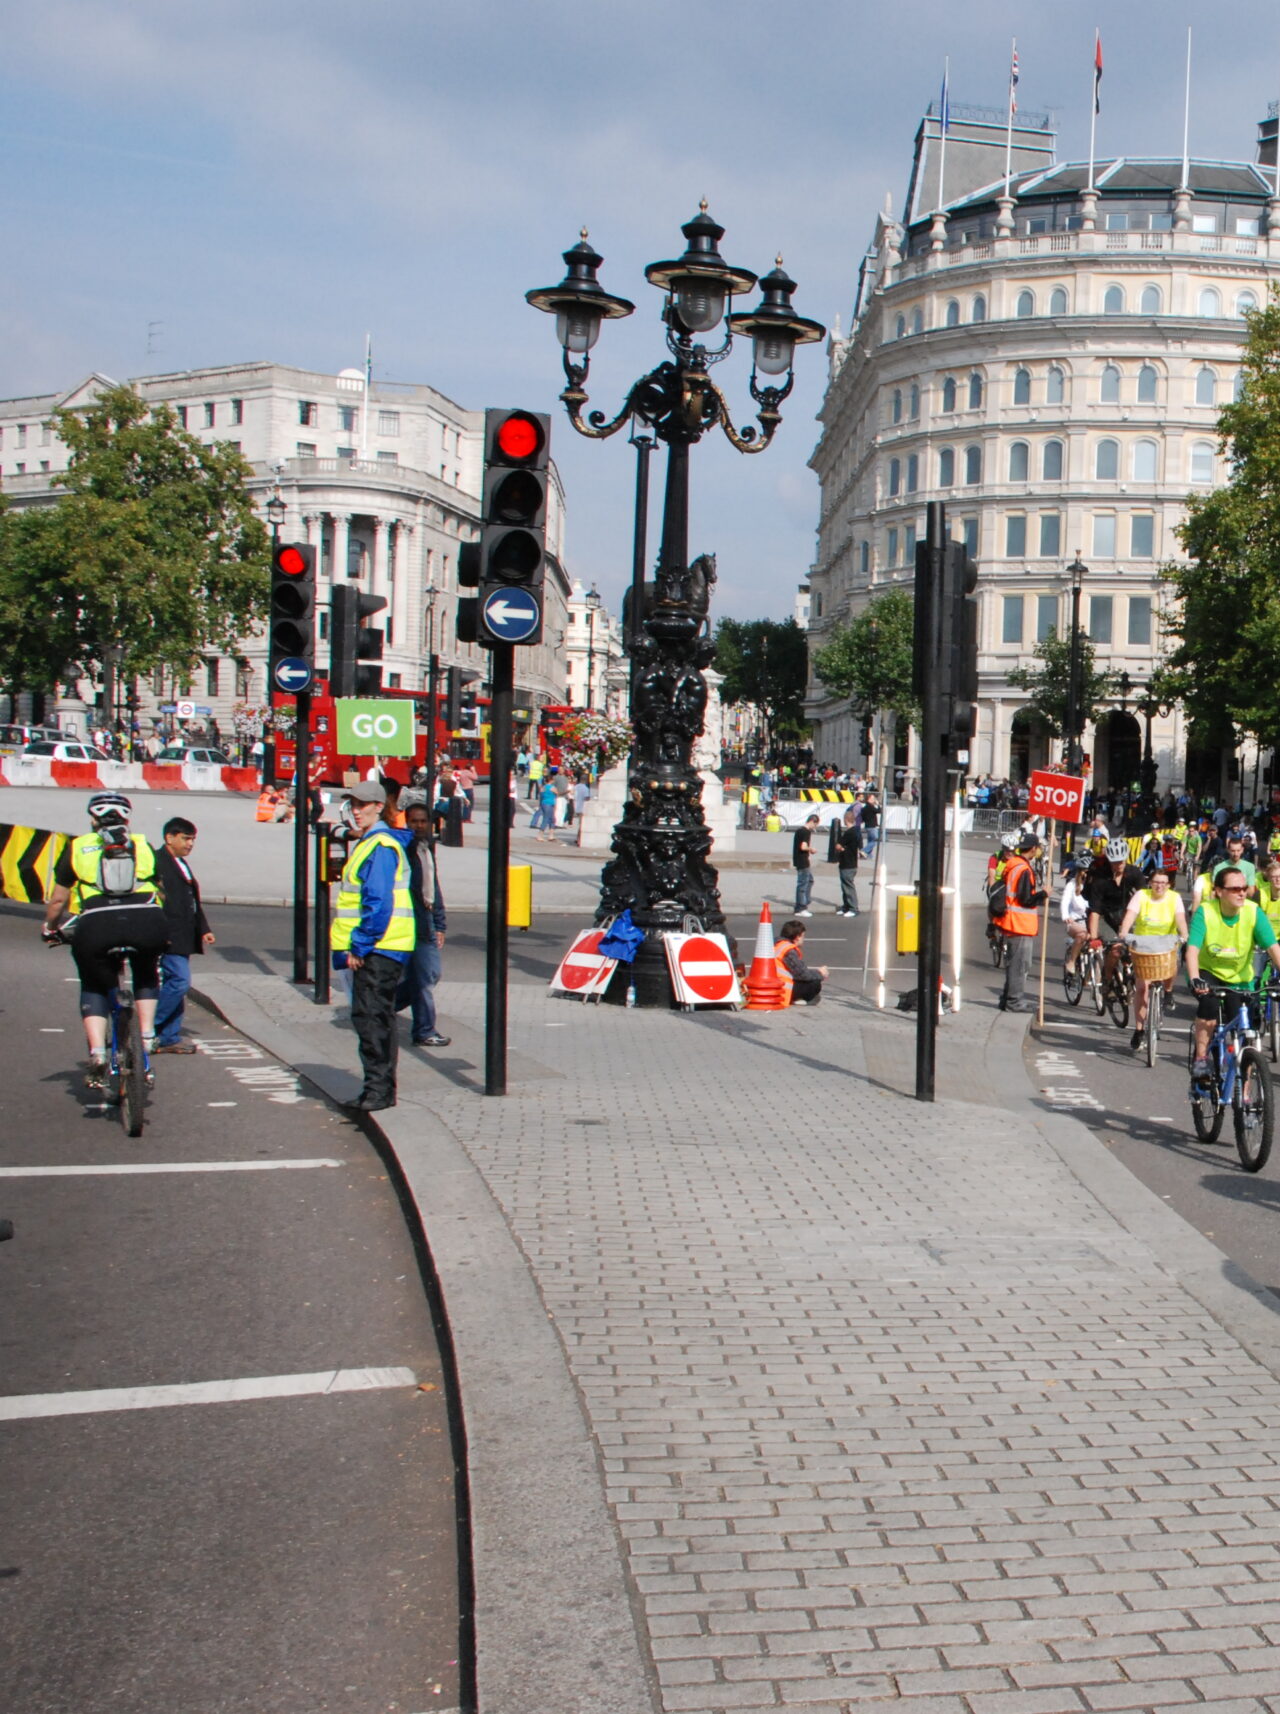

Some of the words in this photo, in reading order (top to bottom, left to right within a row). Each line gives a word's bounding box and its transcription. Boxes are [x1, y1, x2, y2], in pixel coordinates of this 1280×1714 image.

[351, 713, 398, 739] GO
[1033, 784, 1079, 808] STOP
[192, 1039, 263, 1060] LEFT
